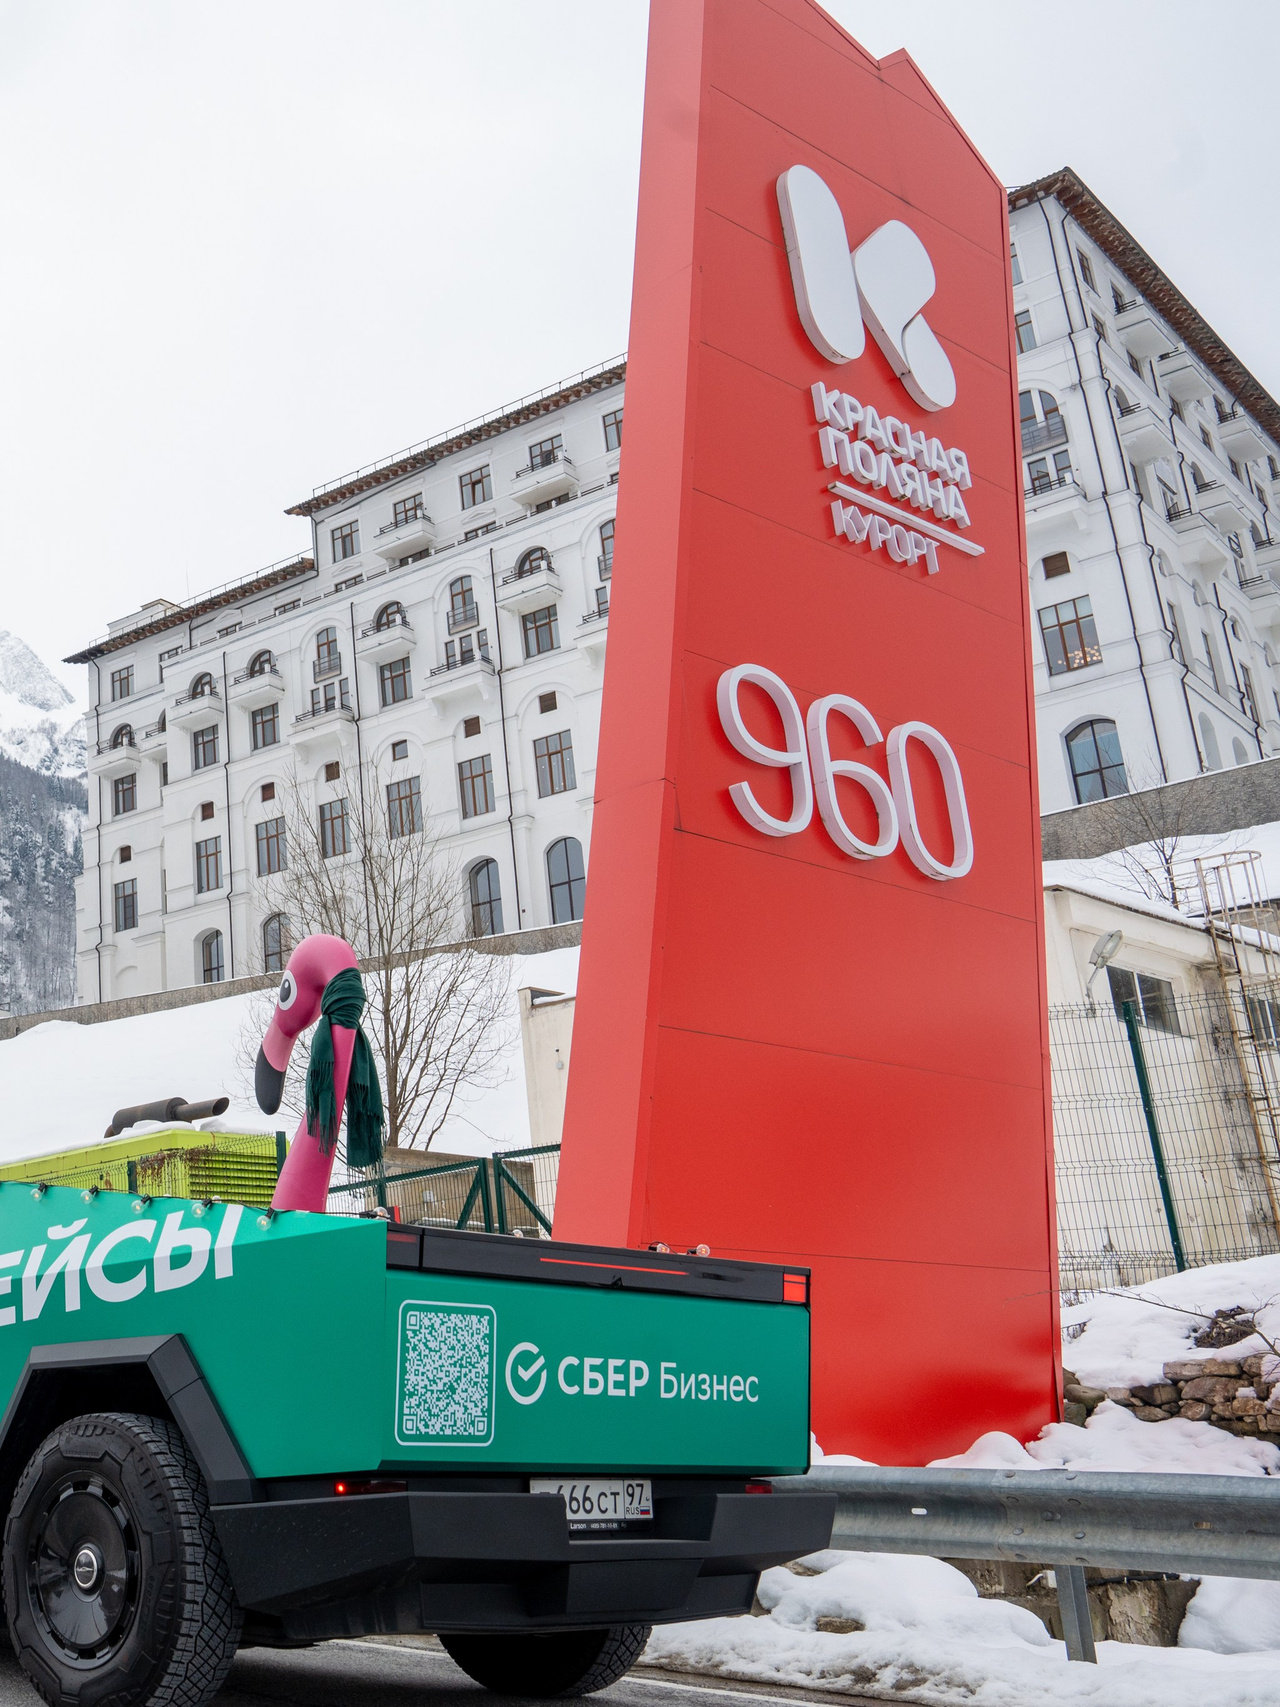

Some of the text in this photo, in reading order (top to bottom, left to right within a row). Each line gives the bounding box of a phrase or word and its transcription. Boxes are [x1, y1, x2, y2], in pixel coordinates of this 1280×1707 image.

[811, 381, 972, 491] КРАСНАЯ
[819, 426, 971, 529] ПОЛЯНА
[831, 499, 940, 575] КУРОРТ
[716, 663, 974, 881] 960
[558, 1356, 759, 1402] СБЕР Бизнес
[626, 1483, 644, 1505] 97
[626, 1506, 639, 1515] RUS
